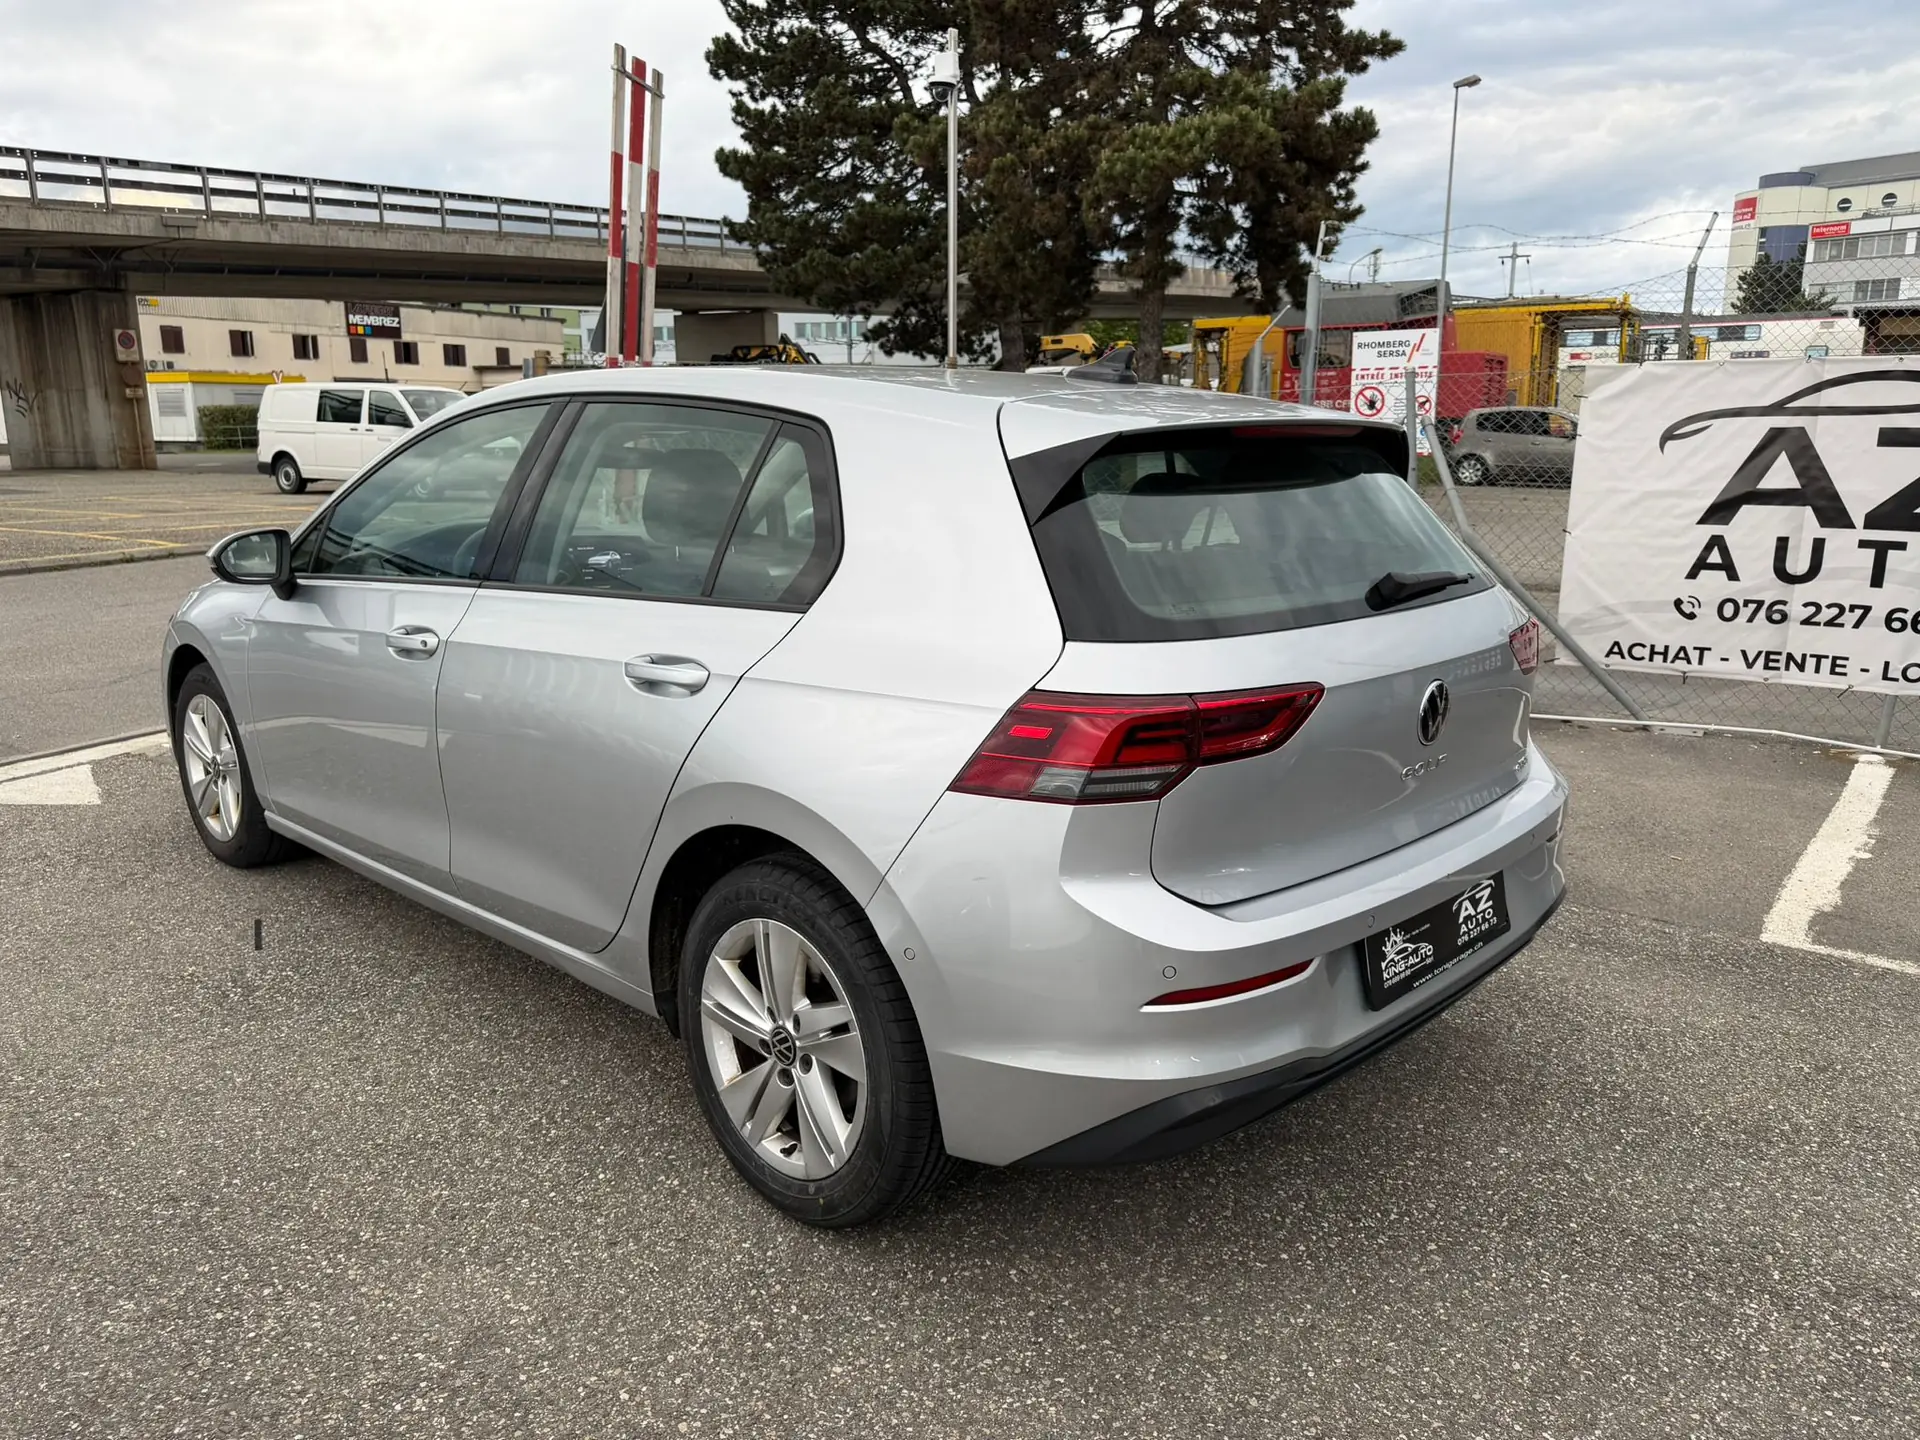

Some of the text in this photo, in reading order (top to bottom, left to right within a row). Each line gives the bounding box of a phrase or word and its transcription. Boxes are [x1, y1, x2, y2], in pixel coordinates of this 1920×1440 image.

[1813, 224, 1847, 233] Internorm
[348, 314, 400, 327] MEMBREZ
[1357, 340, 1411, 349] RHOMBERG
[1377, 350, 1407, 358] SERSA
[1355, 371, 1433, 380] ENTRÉE INTDITE
[1684, 534, 1908, 589] AUT
[1716, 597, 1789, 625] 076
[1799, 601, 1872, 629] 227
[1604, 640, 1712, 666] ACHAT
[1740, 649, 1849, 677] VENTE
[1400, 753, 1448, 780] GOLF
[1458, 886, 1493, 924] AZ
[1457, 934, 1469, 945] 076
[1470, 926, 1480, 938] 227
[1481, 921, 1489, 931] 66
[1460, 908, 1493, 935] AUTO
